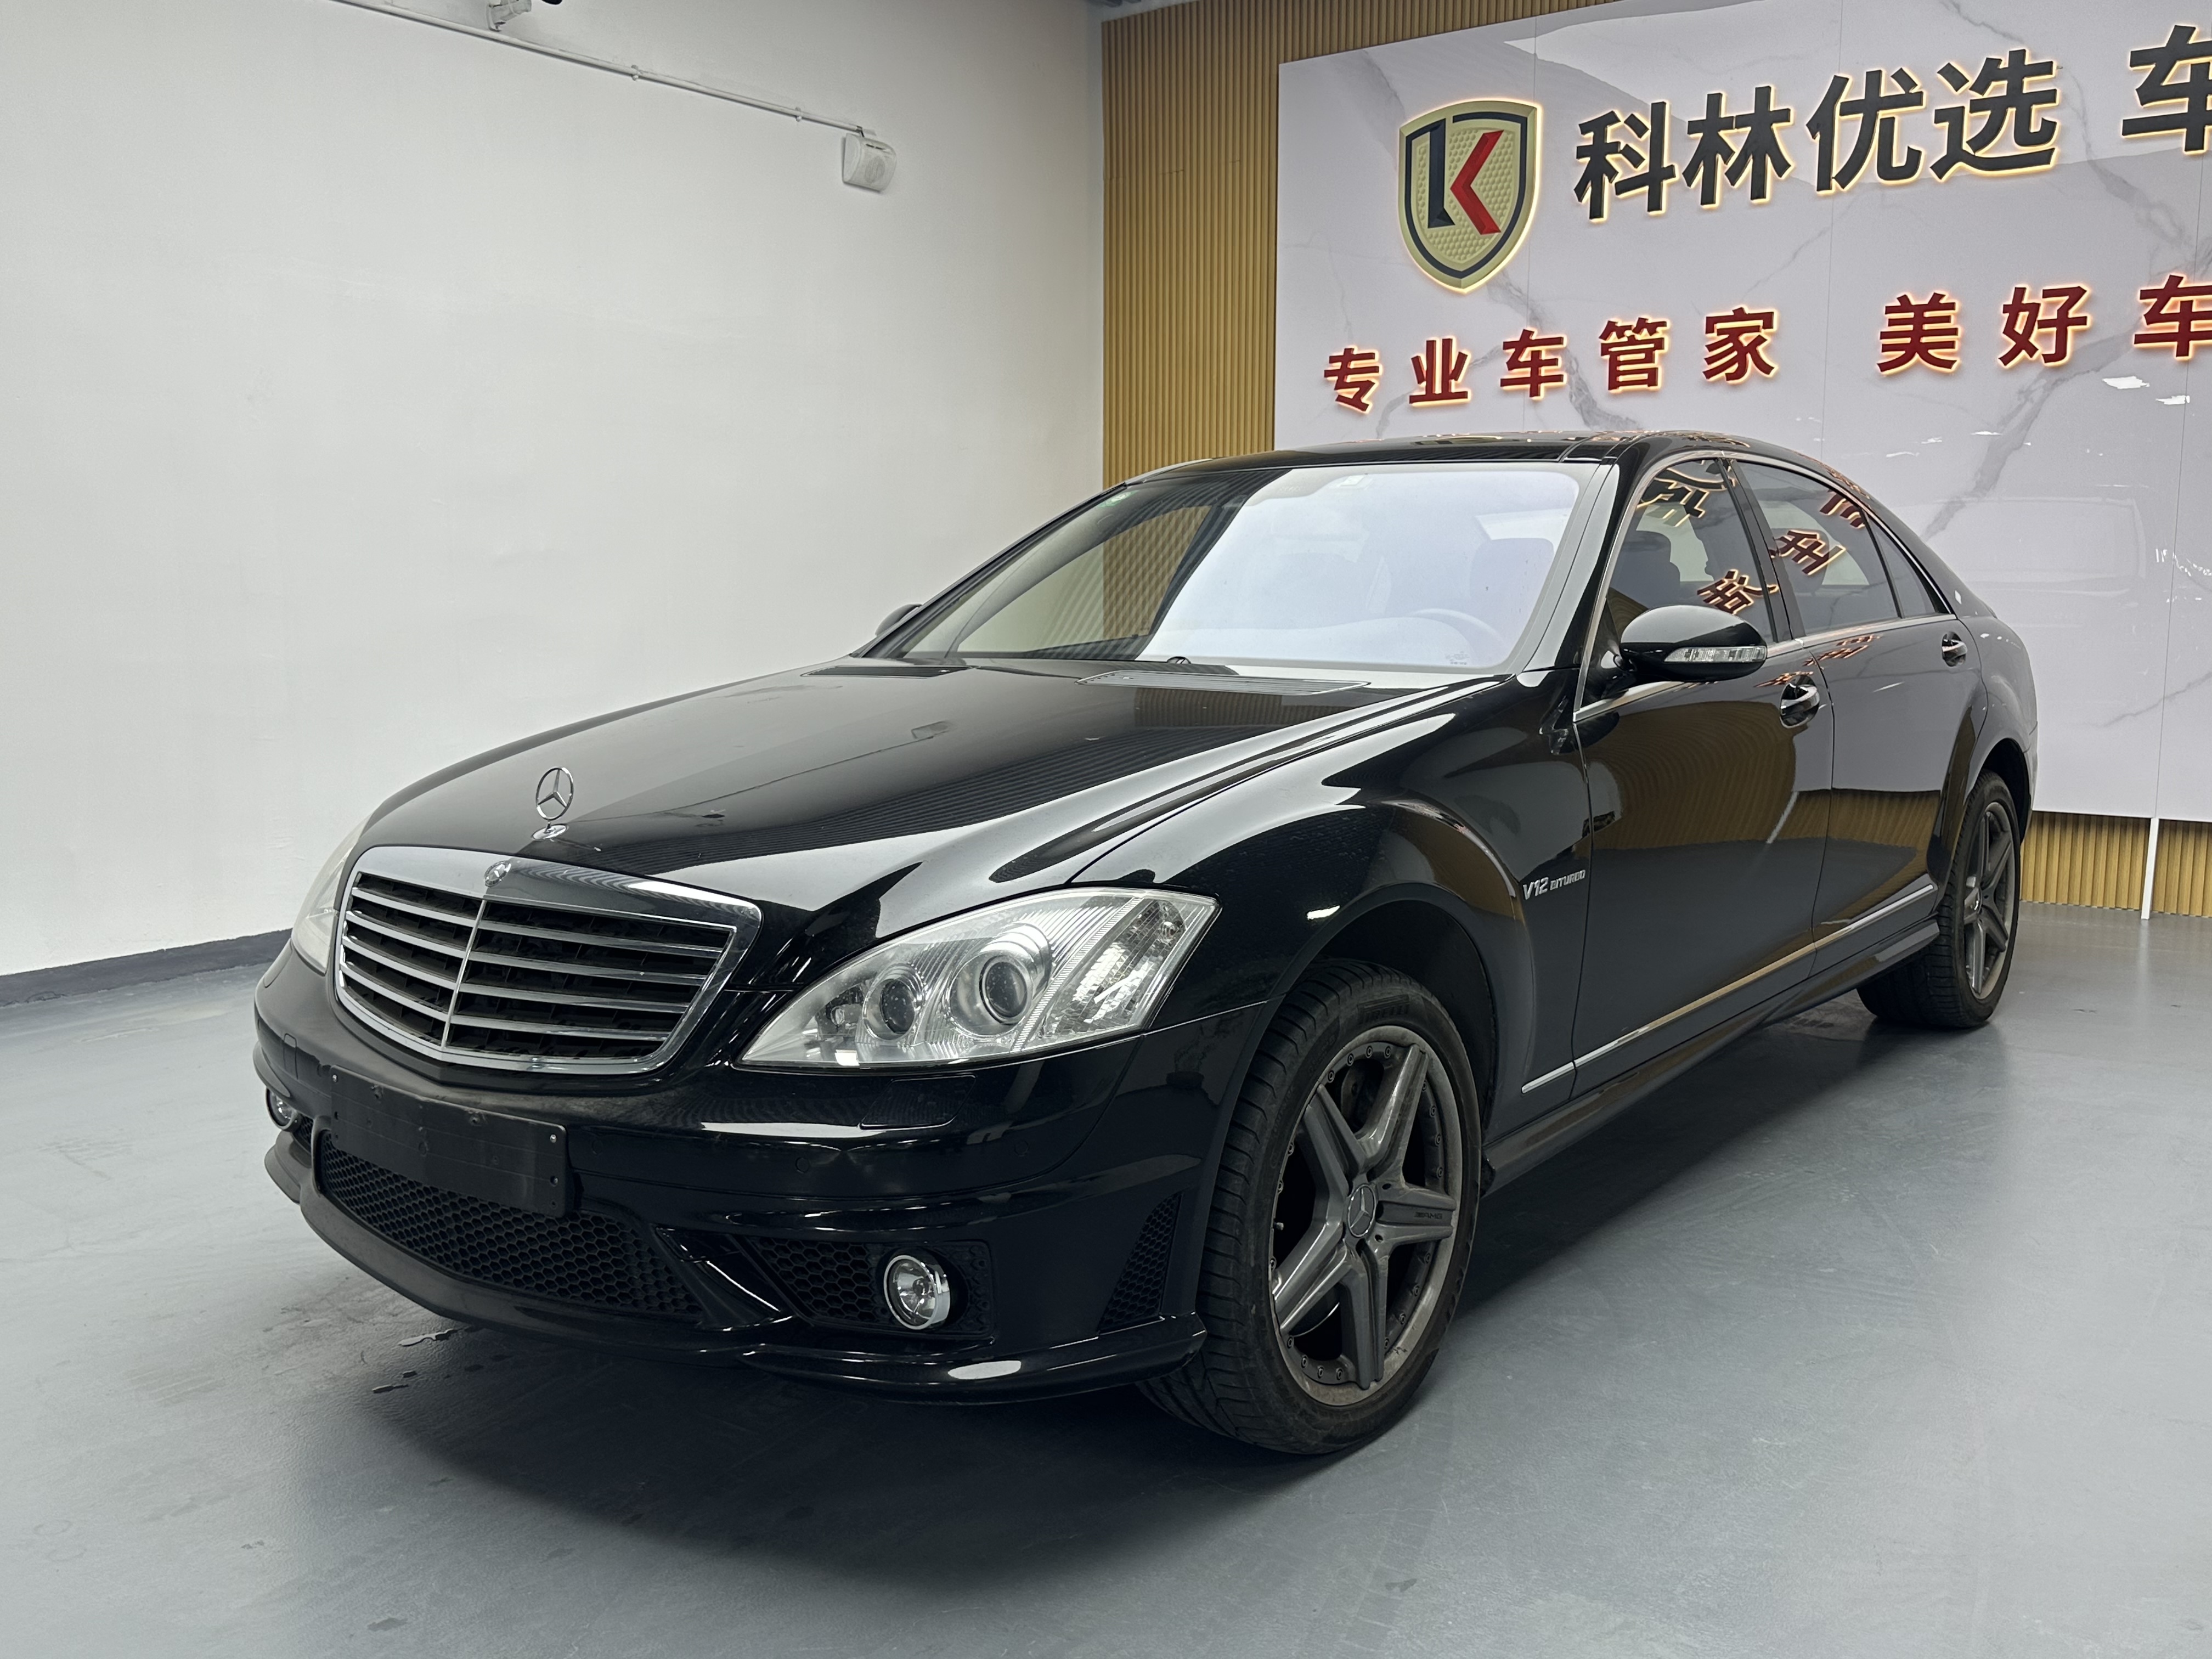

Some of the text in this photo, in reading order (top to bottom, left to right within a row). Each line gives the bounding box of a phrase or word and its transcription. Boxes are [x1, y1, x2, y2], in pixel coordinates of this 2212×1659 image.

[1573, 48, 2058, 221] 科林优选
[1323, 275, 2212, 413] 专业车管家 美好车
[1522, 869, 1585, 900] V12 BITURBO
